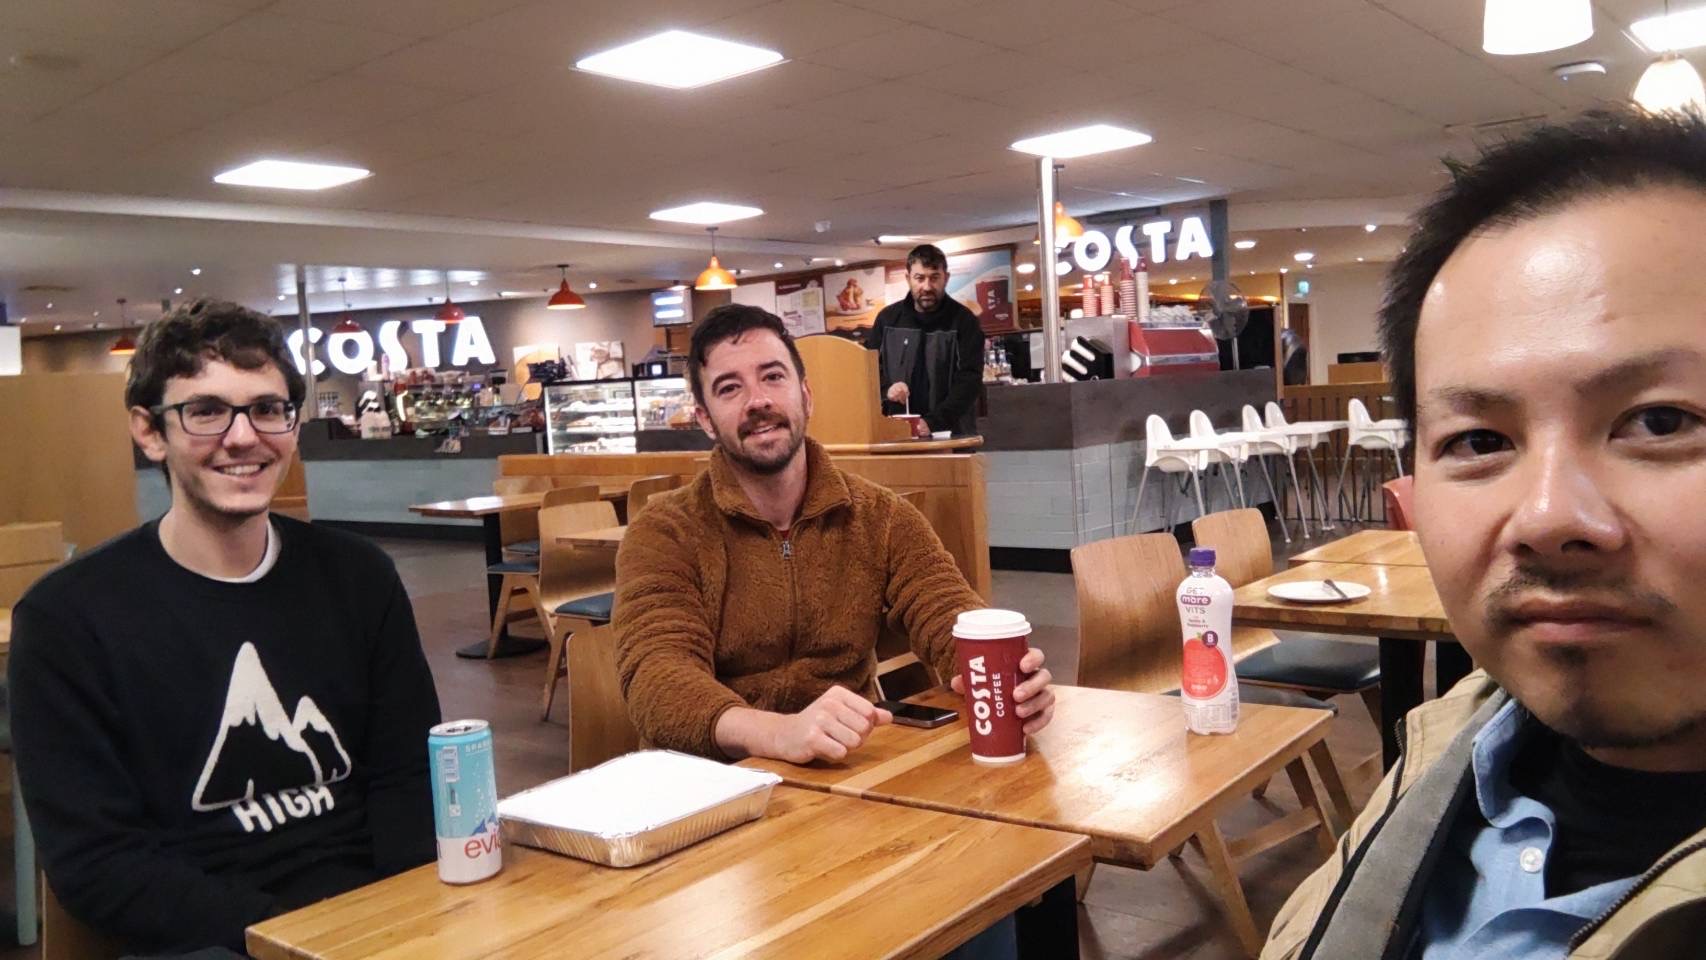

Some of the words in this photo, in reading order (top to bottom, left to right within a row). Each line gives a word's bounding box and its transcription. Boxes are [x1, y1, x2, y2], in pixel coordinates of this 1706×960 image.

[287, 315, 496, 375] COSTA
[1182, 596, 1209, 604] more
[969, 655, 992, 736] COSTA
[992, 672, 1005, 718] COFFEE
[232, 785, 335, 832] HIGH
